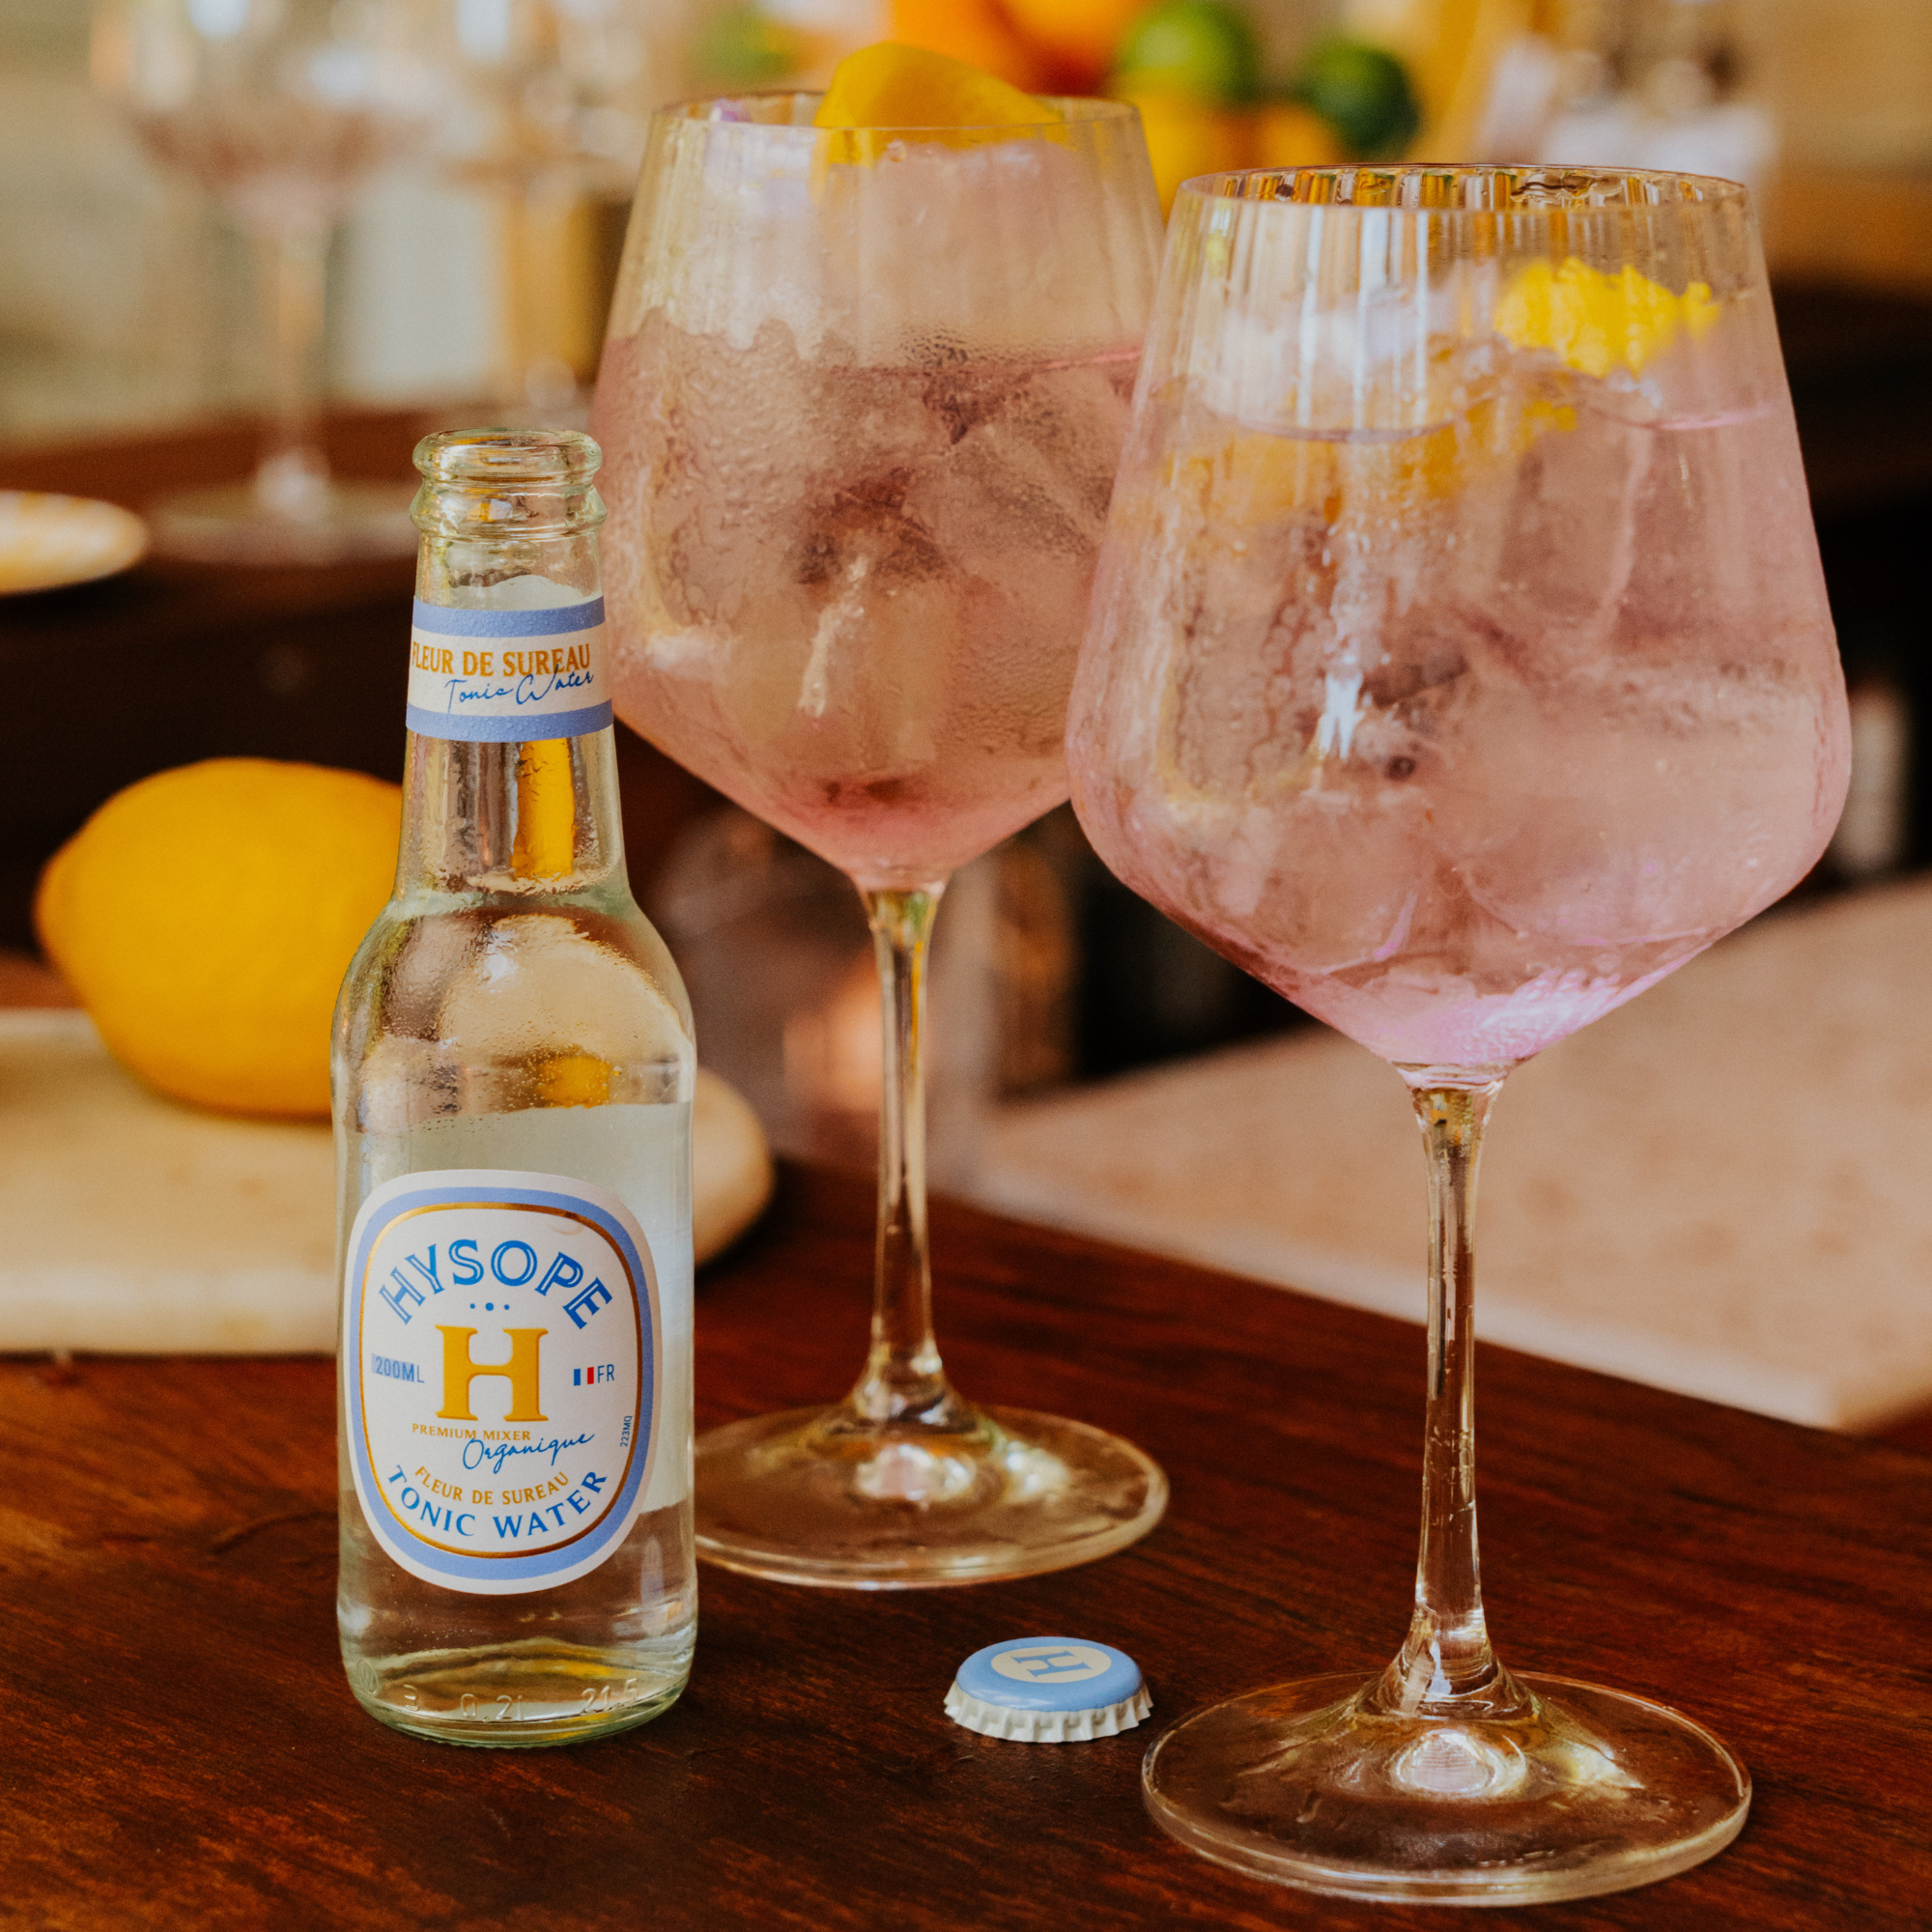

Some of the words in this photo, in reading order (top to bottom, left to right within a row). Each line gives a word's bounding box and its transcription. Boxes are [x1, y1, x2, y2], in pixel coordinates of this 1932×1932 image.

[412, 640, 455, 675] FLEUR
[462, 650, 495, 677] DE
[502, 642, 591, 677] SUREAU
[443, 678, 514, 715] Tonic
[516, 663, 595, 705] Water
[378, 1238, 613, 1330] HYSOPE
[375, 1355, 425, 1383] 200ML
[434, 1323, 550, 1423] H
[596, 1363, 615, 1383] FR
[412, 1422, 477, 1440] PREMIUM
[482, 1430, 531, 1441] MIXER
[619, 1414, 634, 1447] 223MQ
[462, 1433, 596, 1474] Organique
[387, 1464, 477, 1537] TONIC
[492, 1470, 608, 1539] WATER
[413, 1465, 464, 1502] FLEUR
[471, 1490, 494, 1506] DE
[501, 1471, 570, 1506] SUREAU
[1010, 1649, 1094, 1678] H
